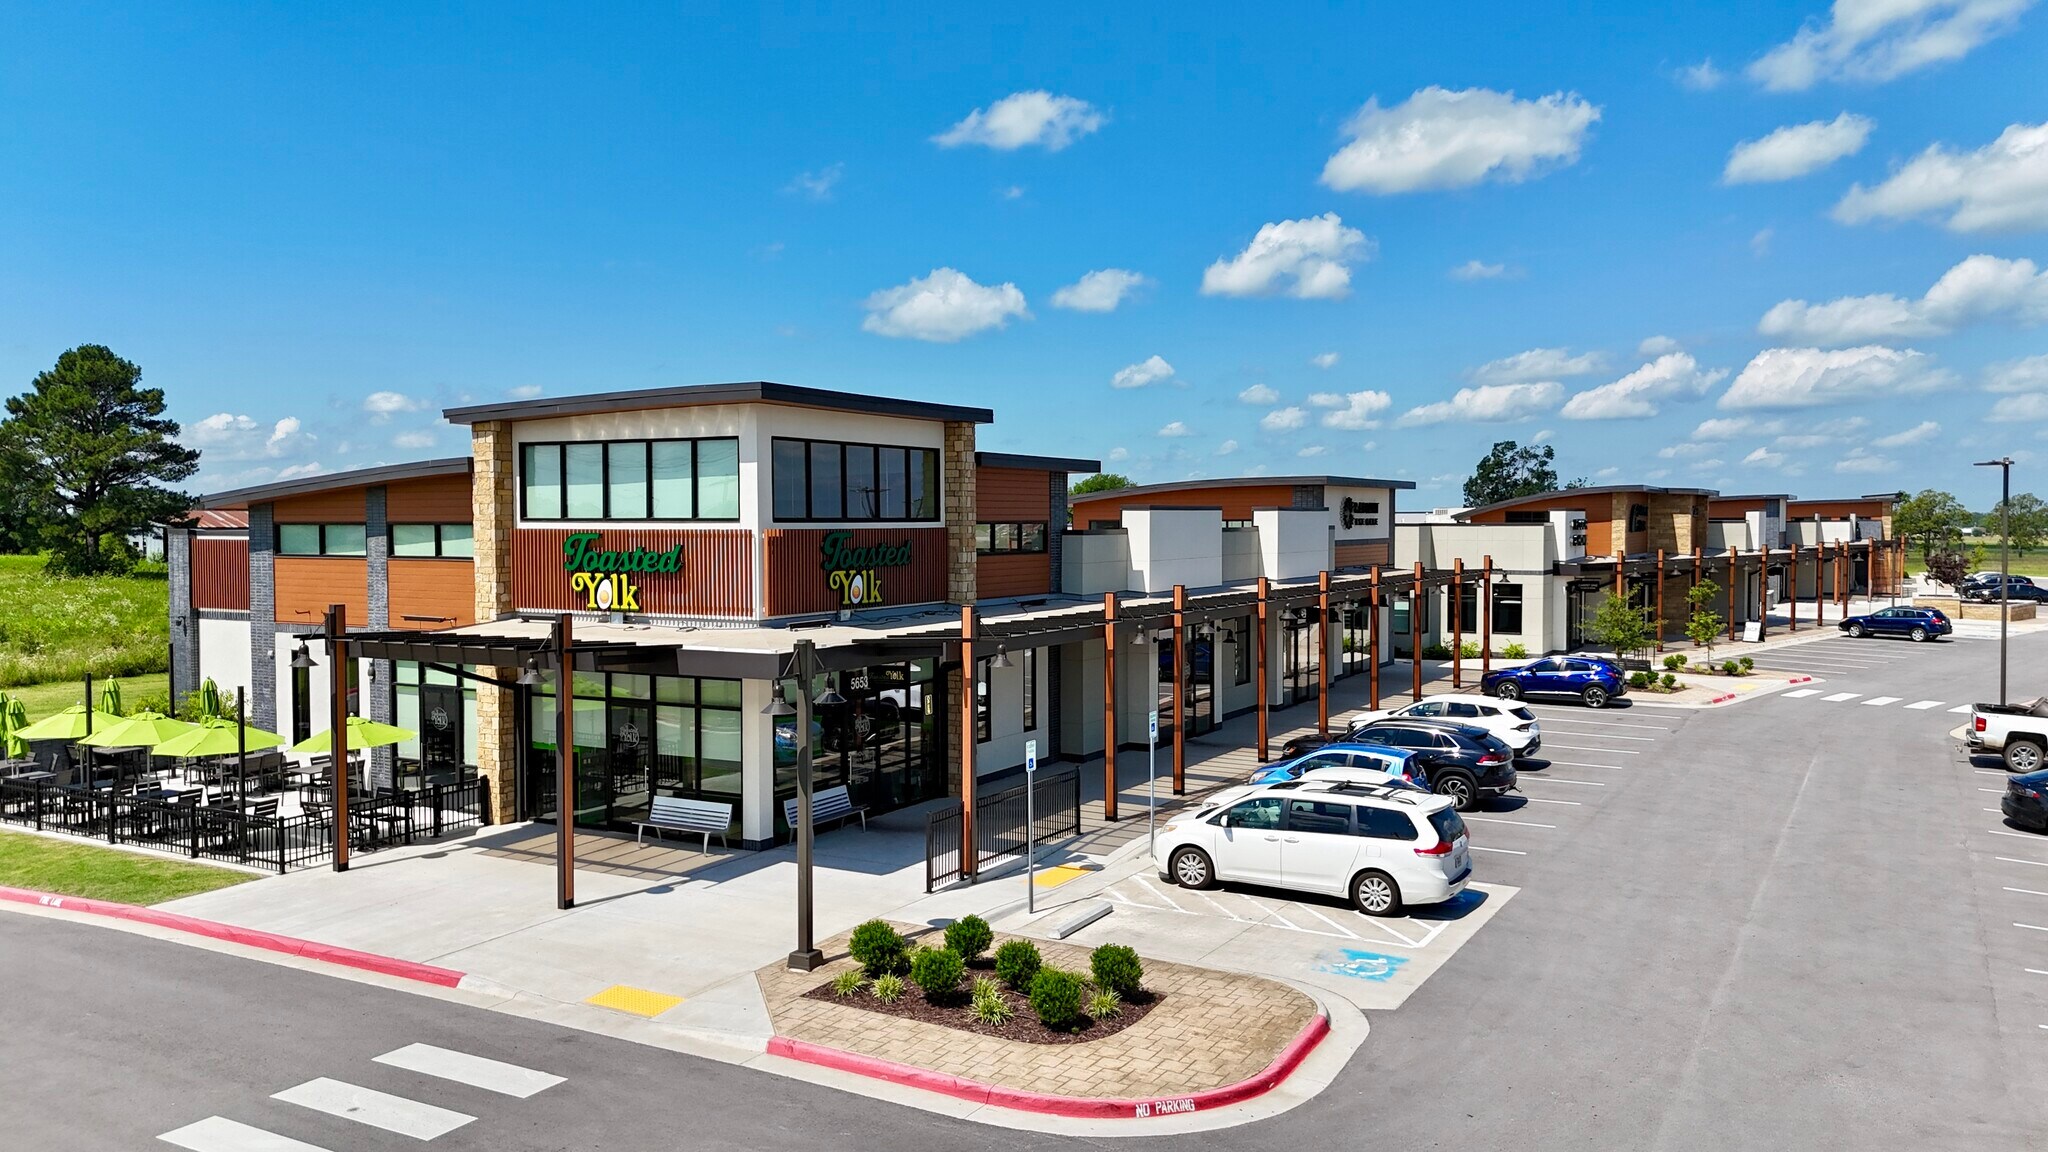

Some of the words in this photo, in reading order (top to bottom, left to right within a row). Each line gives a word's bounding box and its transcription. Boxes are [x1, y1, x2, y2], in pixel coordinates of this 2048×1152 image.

[564, 532, 682, 573] Toasted
[823, 532, 913, 571] Toasted
[571, 572, 640, 610] Yolk
[830, 569, 883, 605] Yolk
[850, 676, 868, 690] 5653
[886, 671, 904, 680] Yolk
[1135, 1103, 1151, 1118] NO
[1155, 1098, 1195, 1115] PARKING
